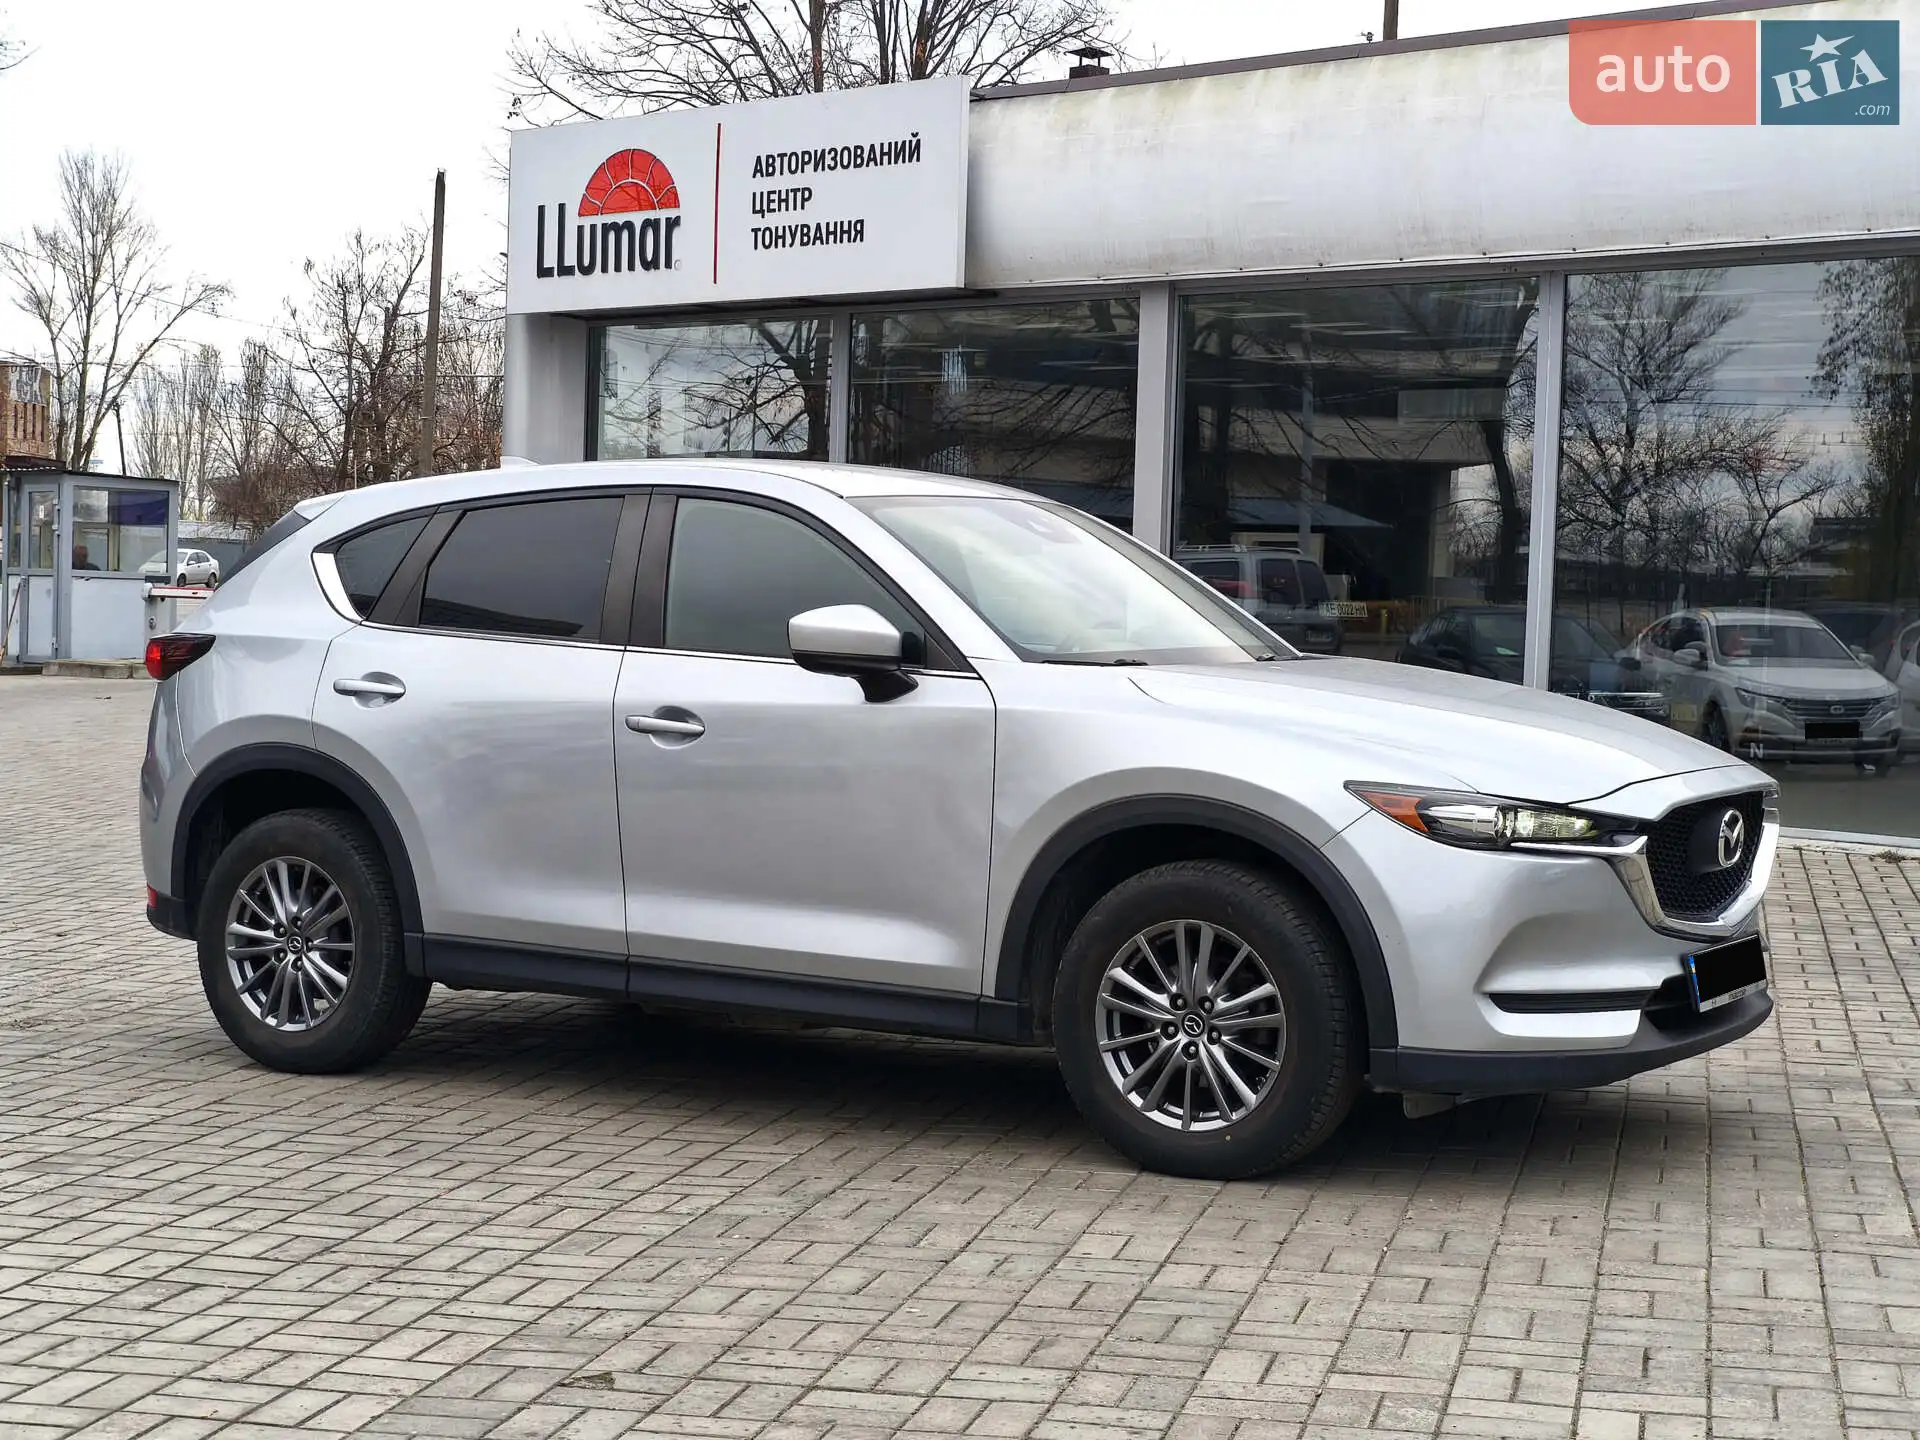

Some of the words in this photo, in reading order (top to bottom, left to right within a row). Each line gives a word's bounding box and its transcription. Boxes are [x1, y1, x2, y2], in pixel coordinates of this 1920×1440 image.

[752, 132, 921, 179] АВТОРИЗОВАНИЙ
[751, 187, 813, 218] ЦЕНТР
[536, 203, 681, 278] LLumar
[751, 219, 864, 251] ТОНУВАННЯ
